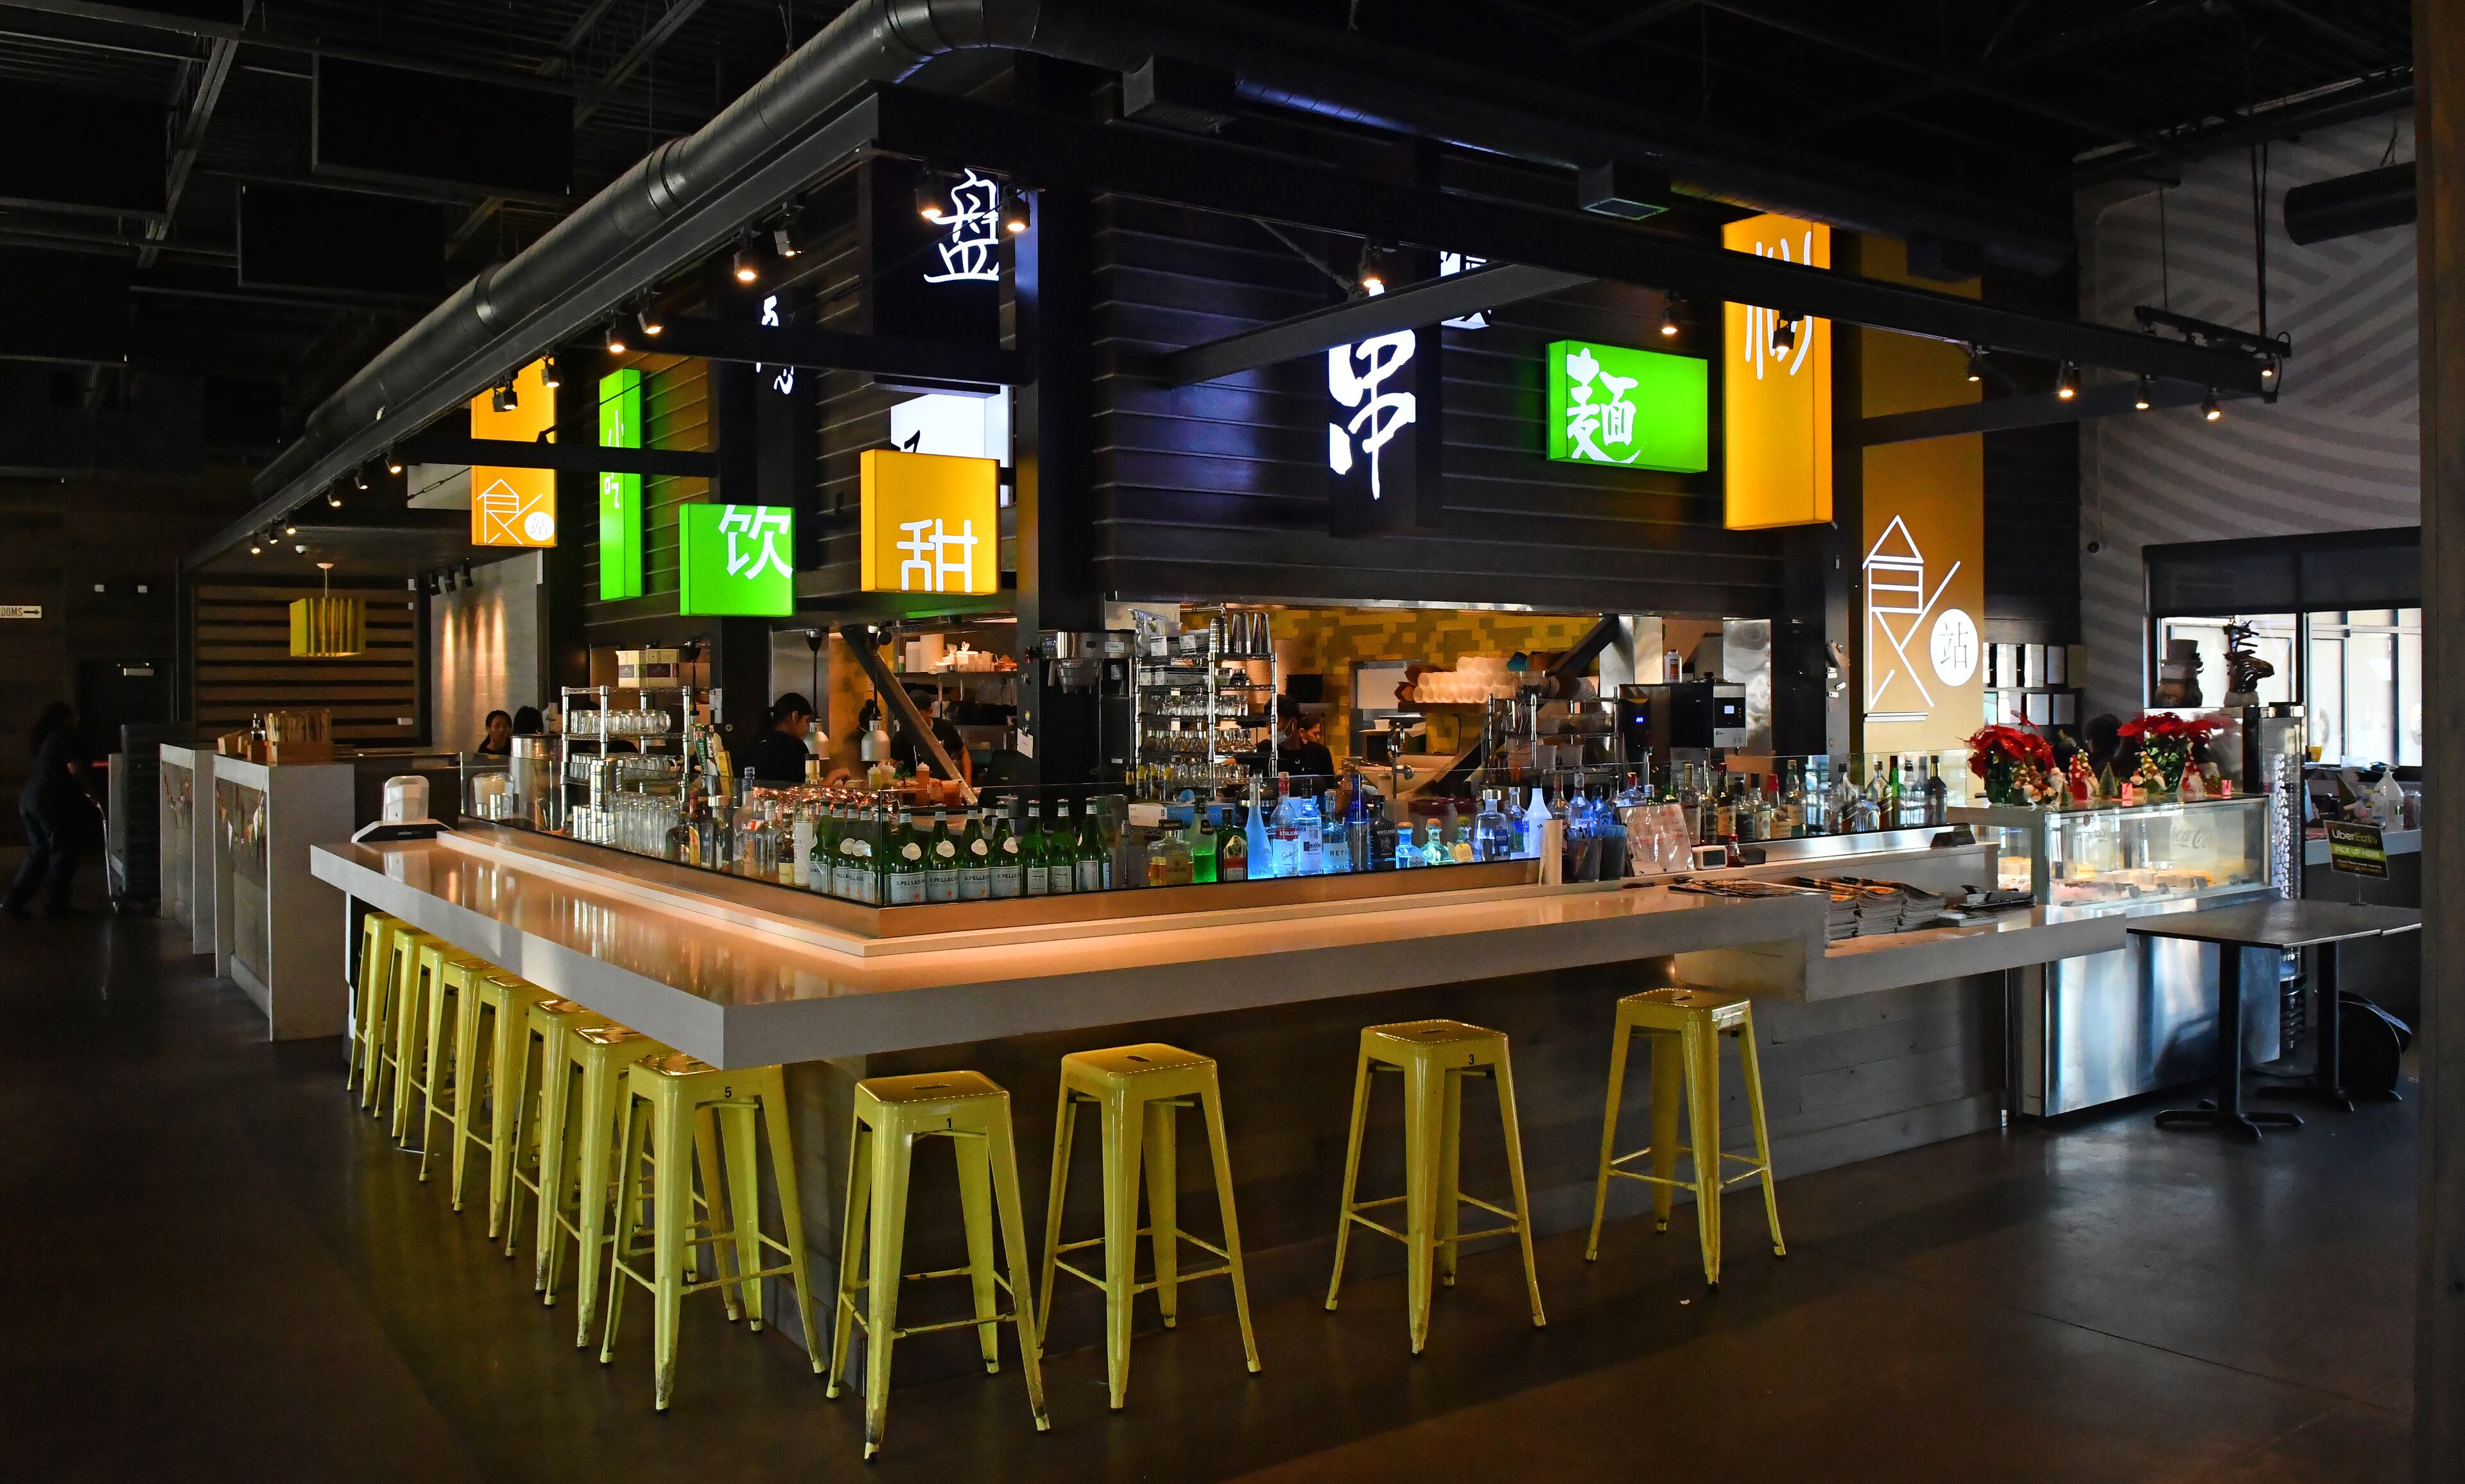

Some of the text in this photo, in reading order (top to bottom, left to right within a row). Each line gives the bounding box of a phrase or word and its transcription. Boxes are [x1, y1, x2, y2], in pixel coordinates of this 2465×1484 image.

[718, 504, 793, 580] 饮
[896, 518, 978, 593] 甜
[1939, 621, 1968, 669] 站
[1469, 1054, 1475, 1065] 3
[725, 1086, 732, 1098] 5
[946, 1117, 951, 1128] 1
